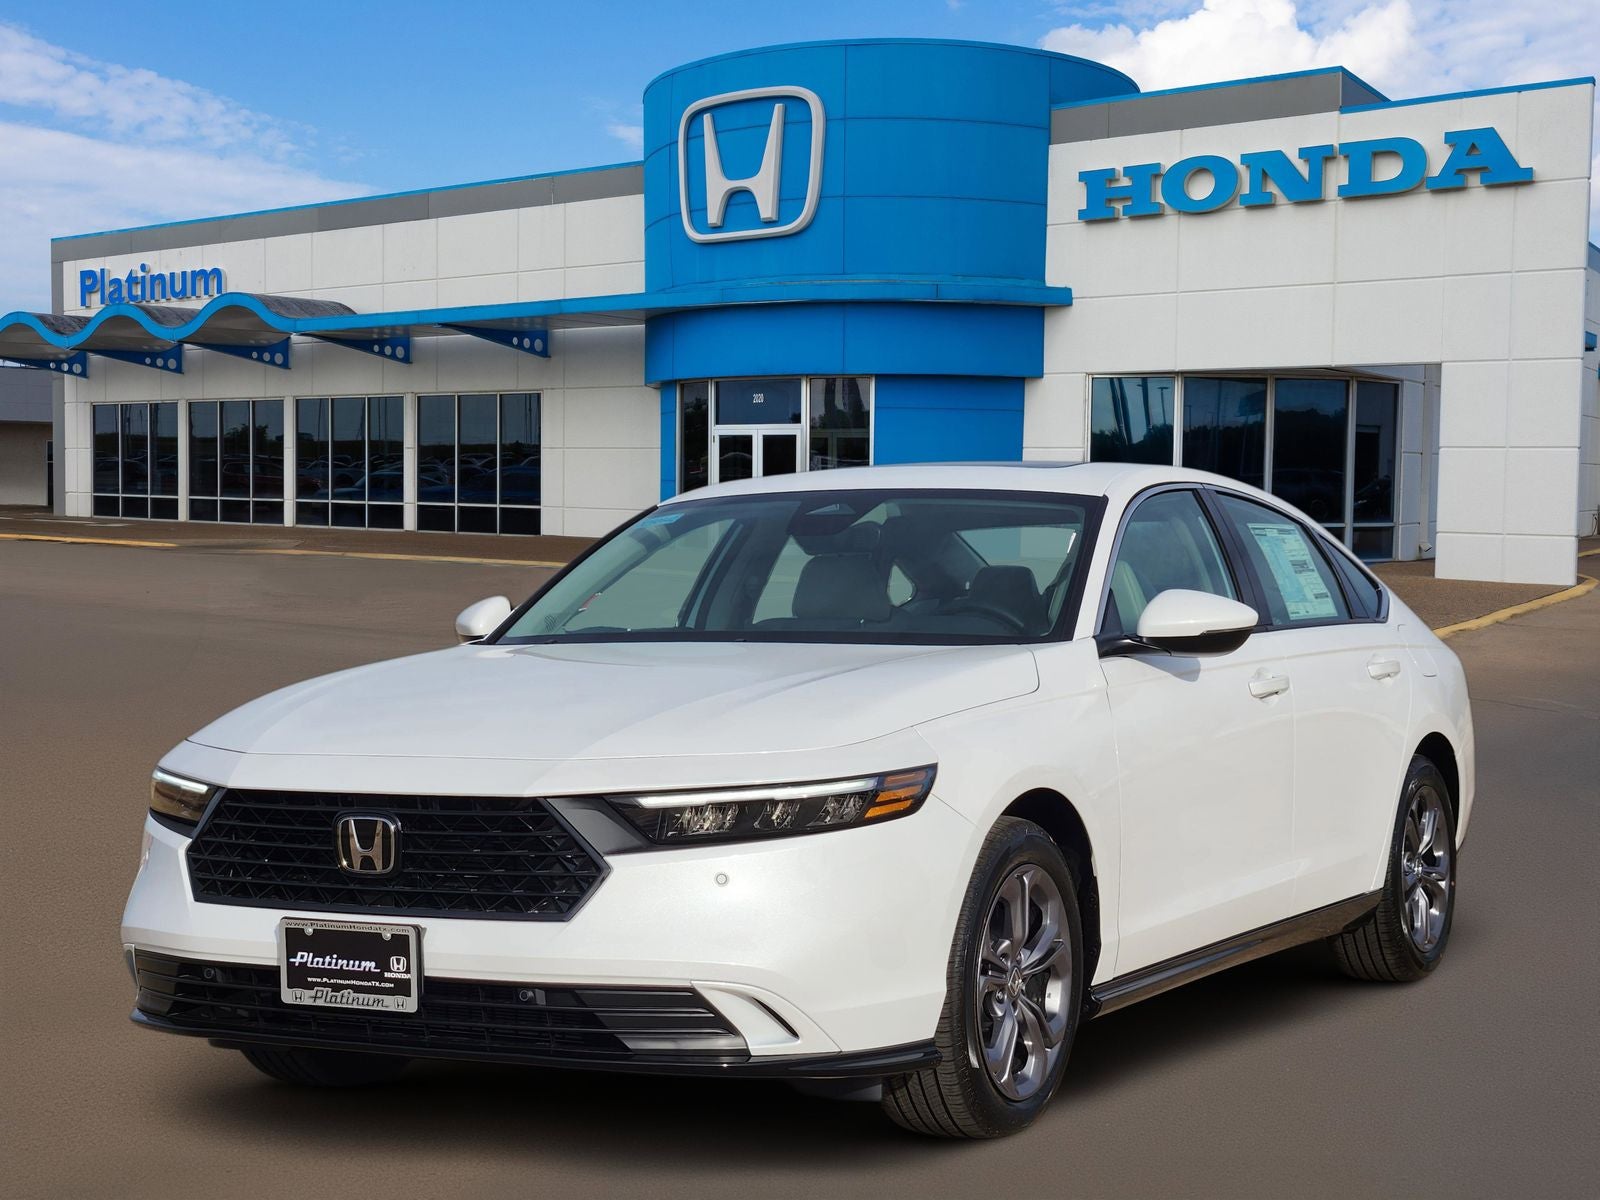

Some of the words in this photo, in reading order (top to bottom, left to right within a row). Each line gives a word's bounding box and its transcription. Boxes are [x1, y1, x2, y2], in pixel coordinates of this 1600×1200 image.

[1077, 126, 1534, 222] HONDA
[79, 263, 226, 307] Platinum
[289, 951, 381, 973] Platinum
[308, 989, 390, 1008] Platinum
